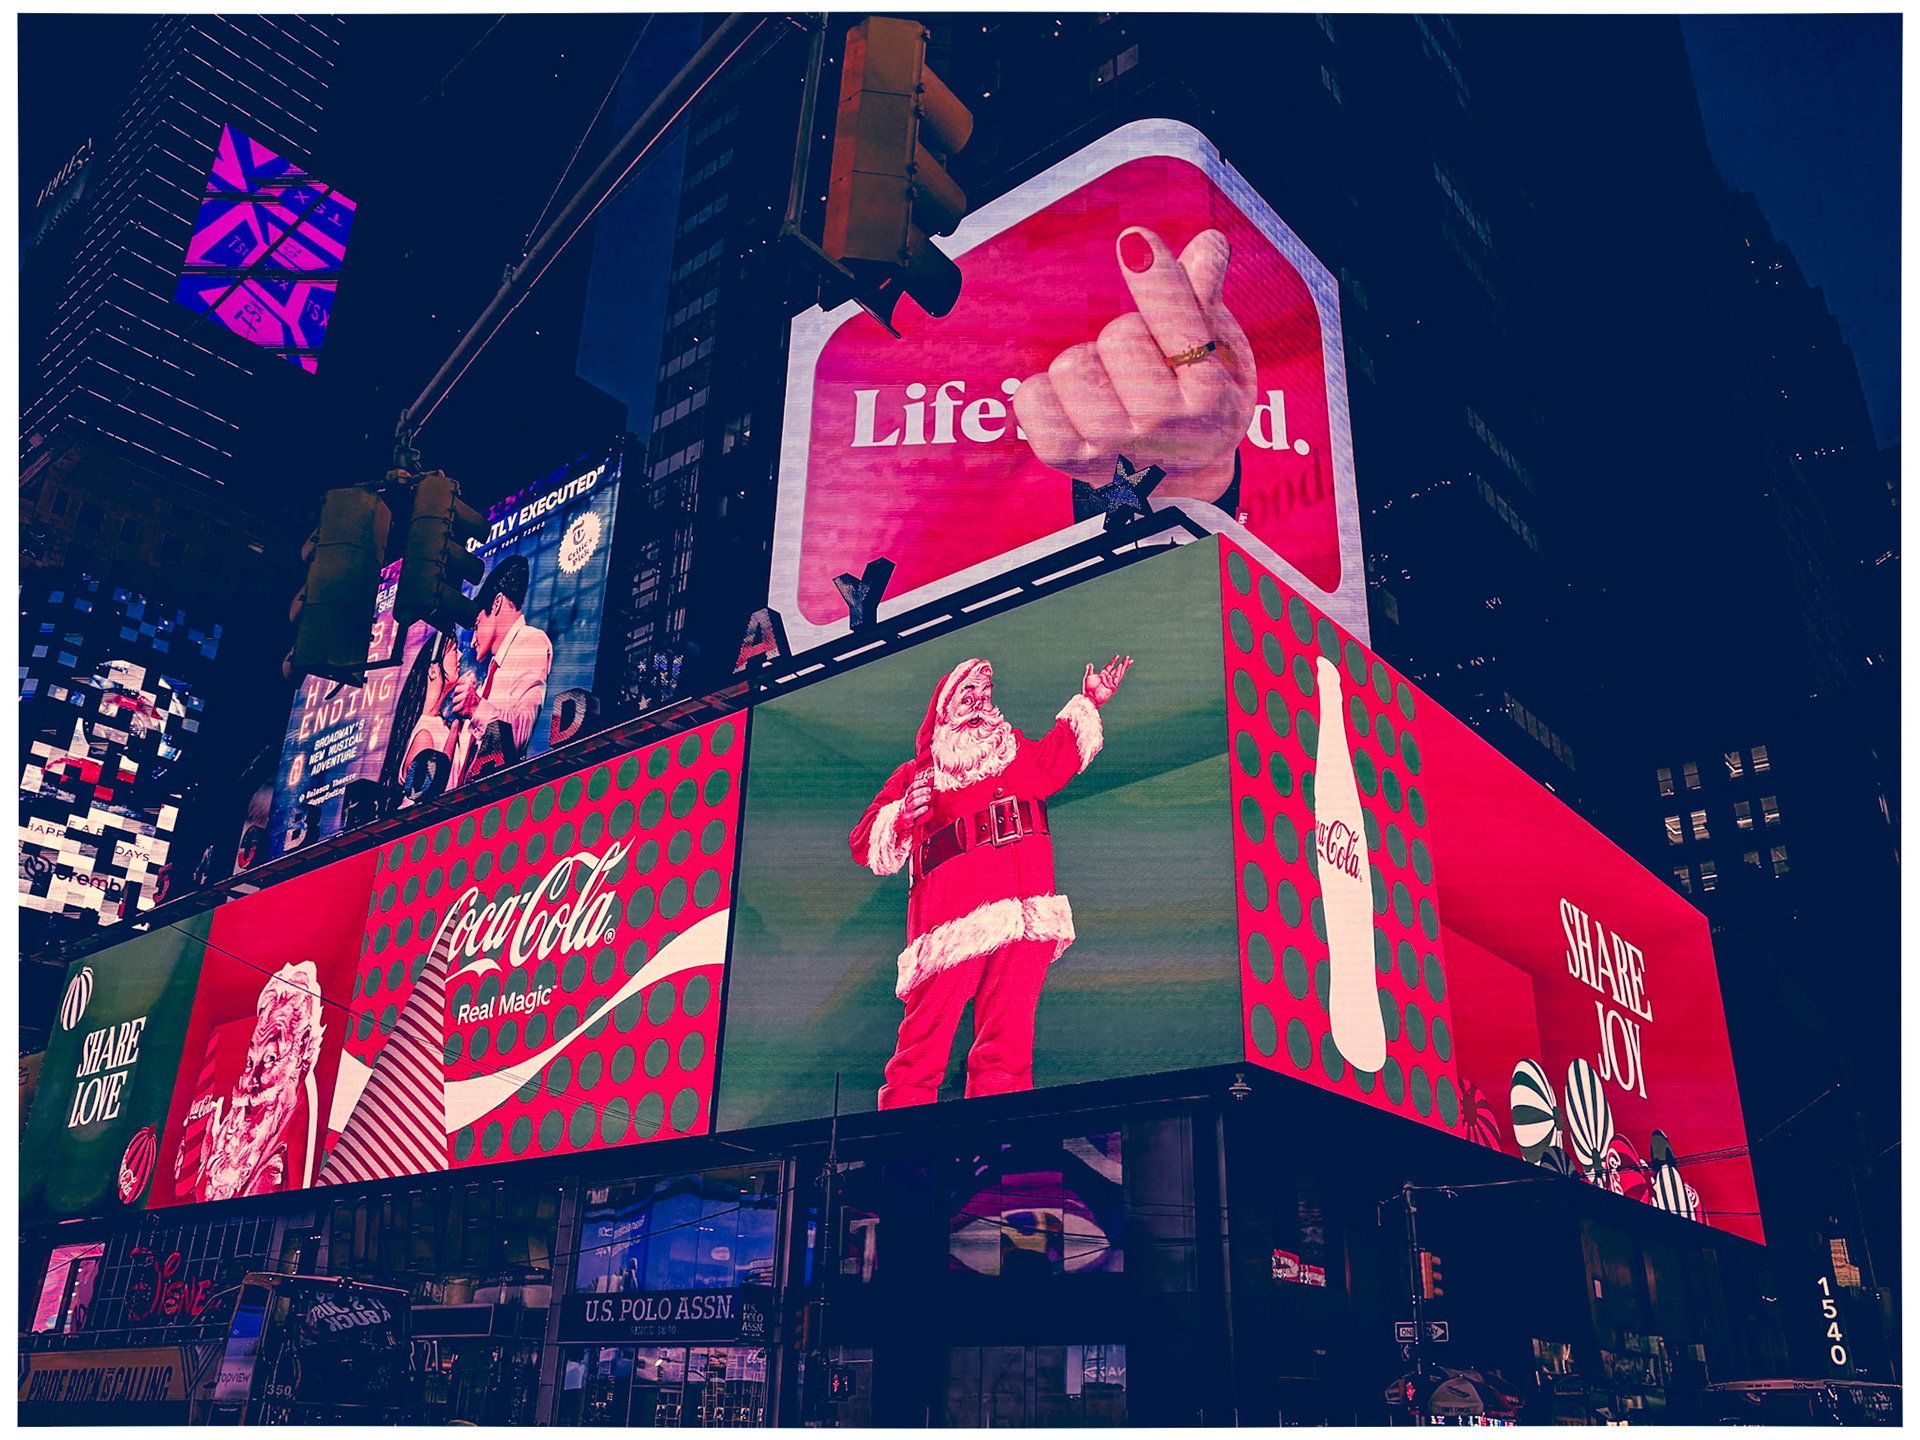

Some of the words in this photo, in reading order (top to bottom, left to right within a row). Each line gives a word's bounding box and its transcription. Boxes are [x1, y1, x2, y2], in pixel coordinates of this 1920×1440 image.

[572, 549, 590, 567] Pick
[298, 672, 394, 741] ENDING
[308, 749, 326, 766] NEW
[328, 732, 364, 756] MUSICAL
[314, 719, 366, 751] BROADWAY'S
[310, 746, 358, 776] ADVENTURE
[1560, 898, 1653, 1023] SHARE
[457, 997, 495, 1026] Real
[76, 1016, 147, 1078] SHARE
[1595, 1000, 1648, 1100] JOY
[67, 1070, 128, 1128] LOVE
[585, 1298, 615, 1323] U.S.
[619, 1297, 672, 1322] POLO
[674, 1294, 735, 1321] ASSN.
[1817, 1276, 1847, 1366] 1540
[27, 1369, 70, 1402] PRIDE
[64, 1367, 106, 1402] ROCK
[111, 1366, 173, 1402] CALLING
[267, 1384, 292, 1396] 350
